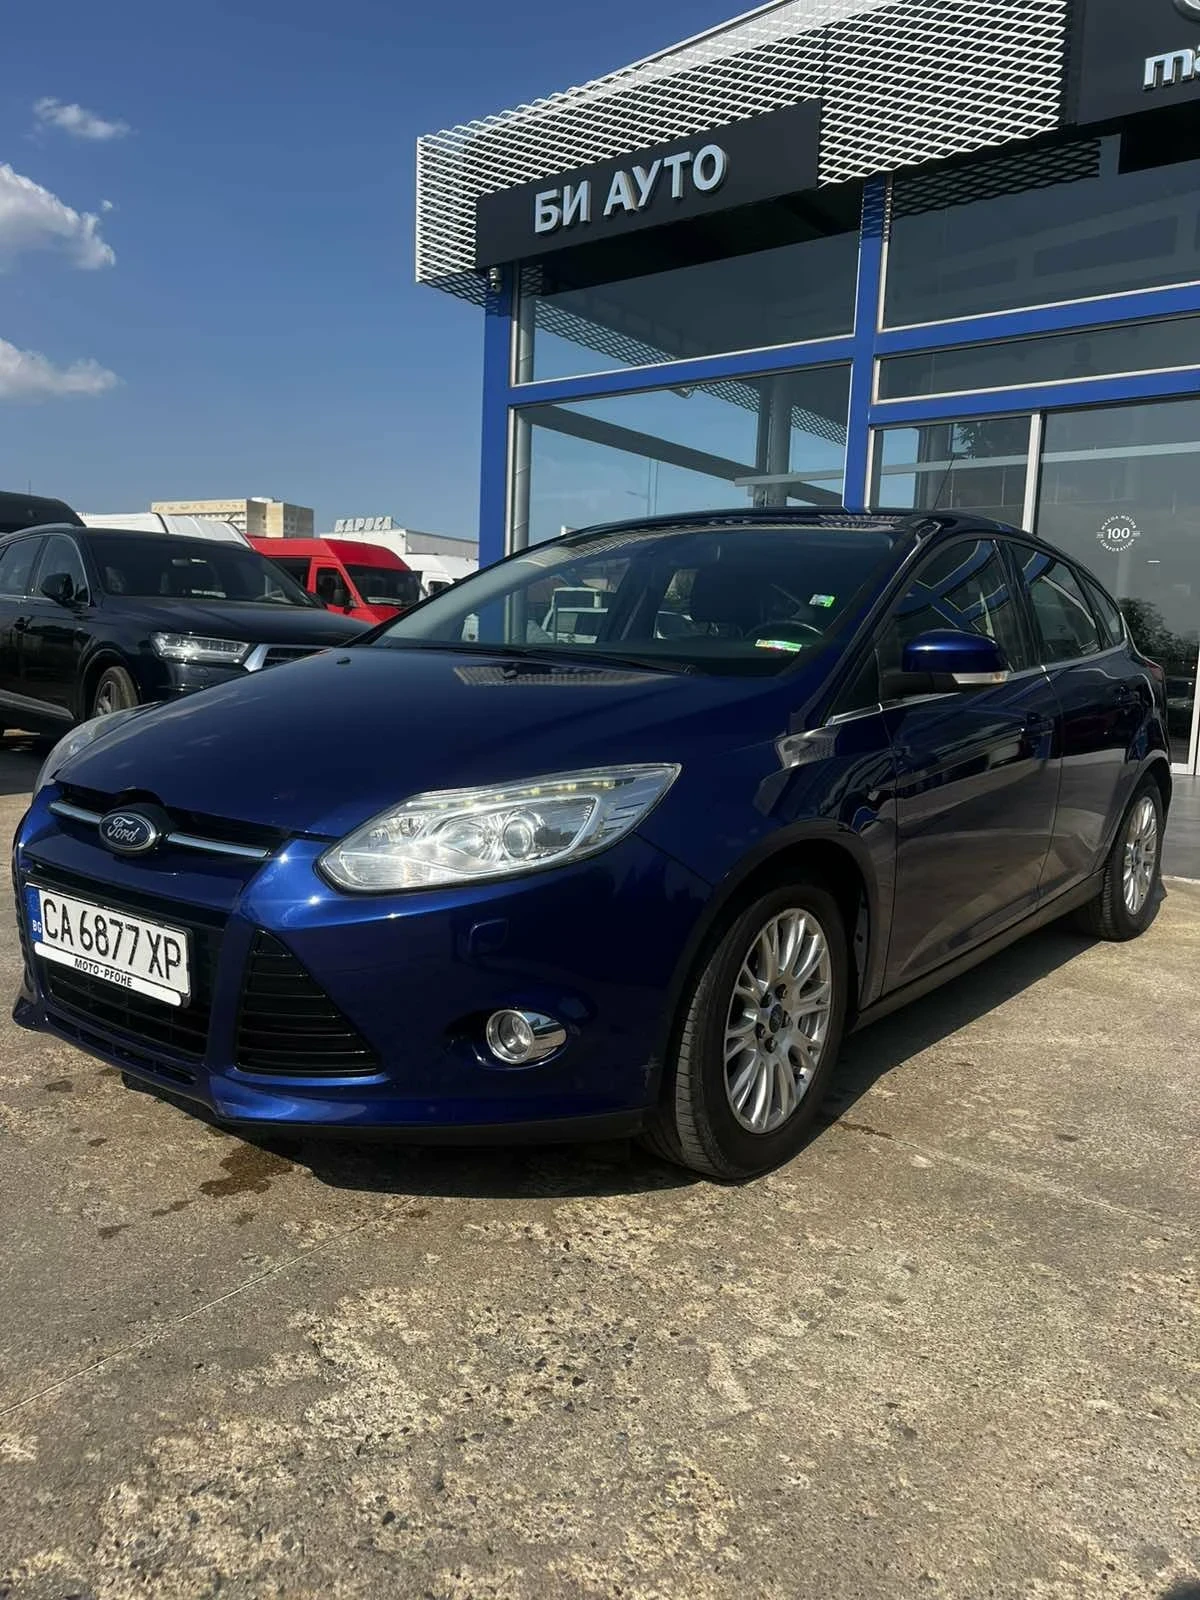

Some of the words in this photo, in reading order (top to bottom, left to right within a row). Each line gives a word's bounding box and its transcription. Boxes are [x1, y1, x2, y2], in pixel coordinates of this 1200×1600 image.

[534, 179, 592, 234] БИ
[603, 143, 728, 216] АУТО
[1106, 527, 1130, 539] 100
[107, 816, 140, 842] Ford
[32, 919, 42, 933] BG
[43, 898, 74, 946] CA
[79, 910, 140, 966] 6877
[146, 929, 181, 980] XP
[74, 957, 133, 988] MOTO-PFOHE
